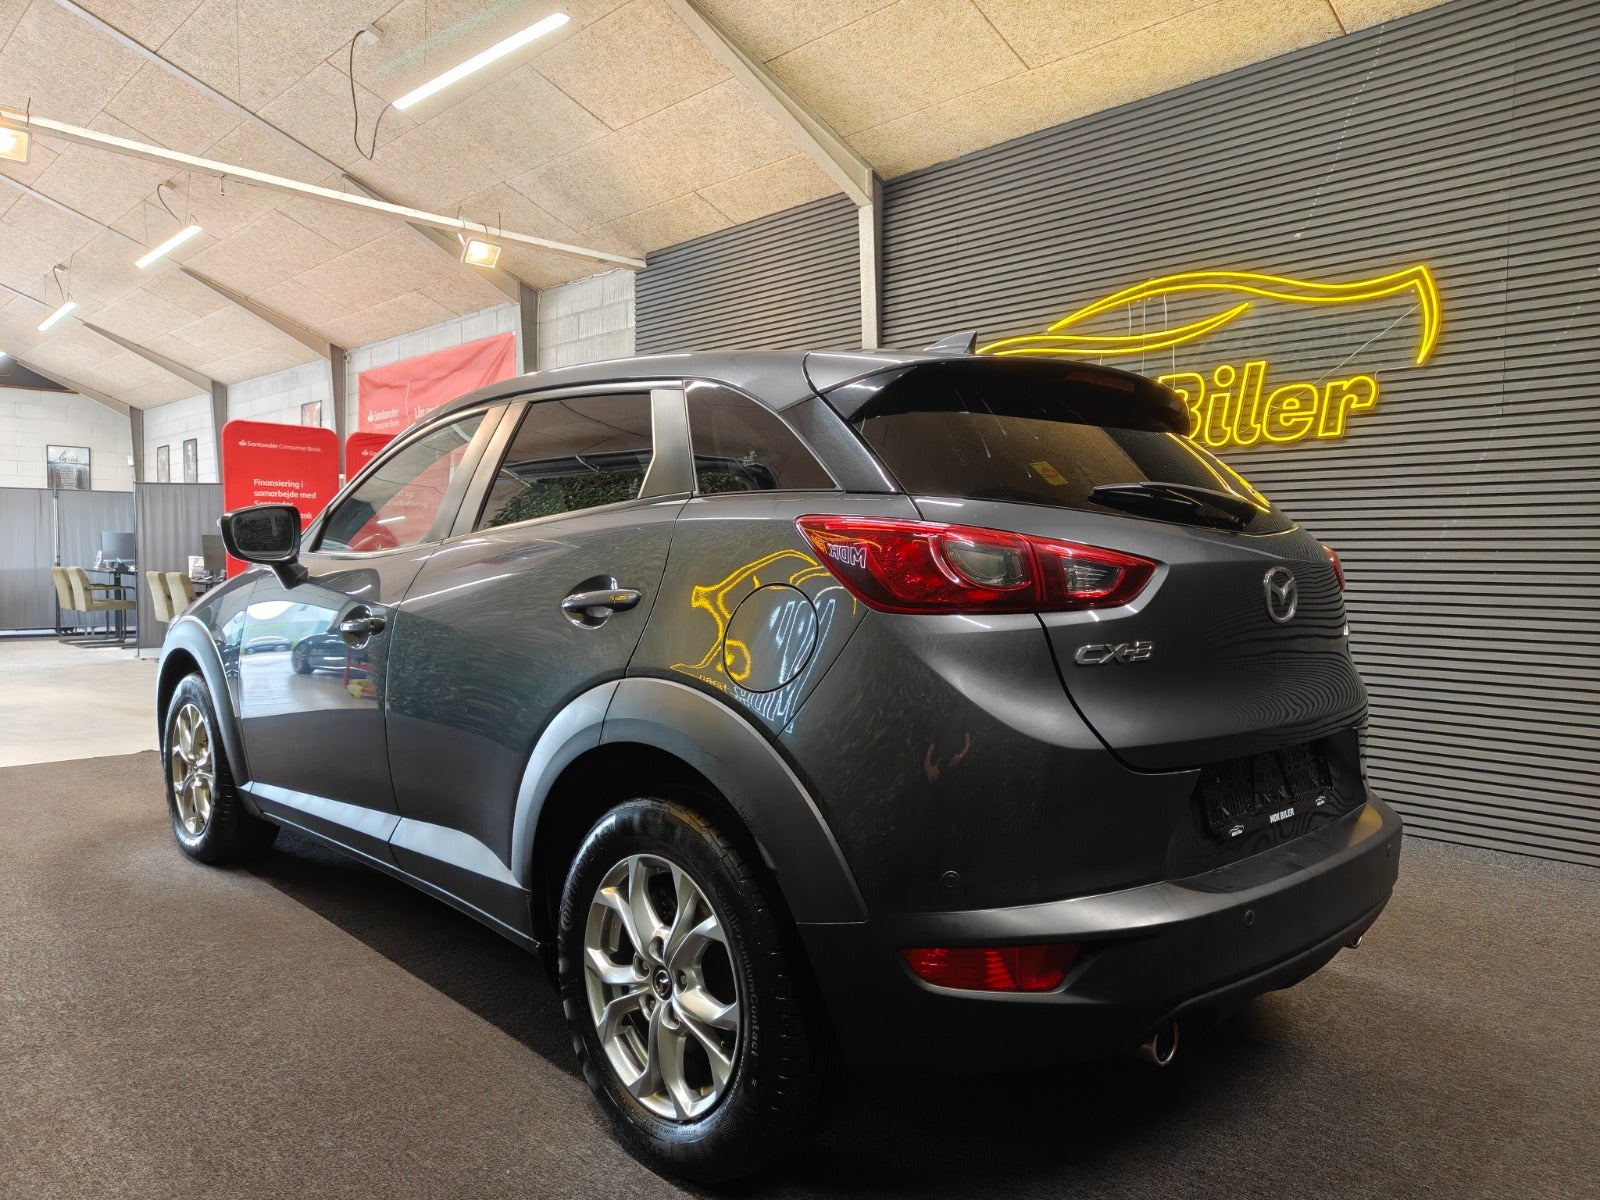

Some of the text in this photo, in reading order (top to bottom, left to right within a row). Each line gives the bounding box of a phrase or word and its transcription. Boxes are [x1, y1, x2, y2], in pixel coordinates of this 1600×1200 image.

[373, 408, 399, 421] Santander
[247, 440, 278, 449] Santander
[279, 443, 306, 451] Consumer
[253, 478, 300, 489] Finansiering
[254, 490, 317, 499] samarbejde med
[1074, 641, 1153, 664] CX-3
